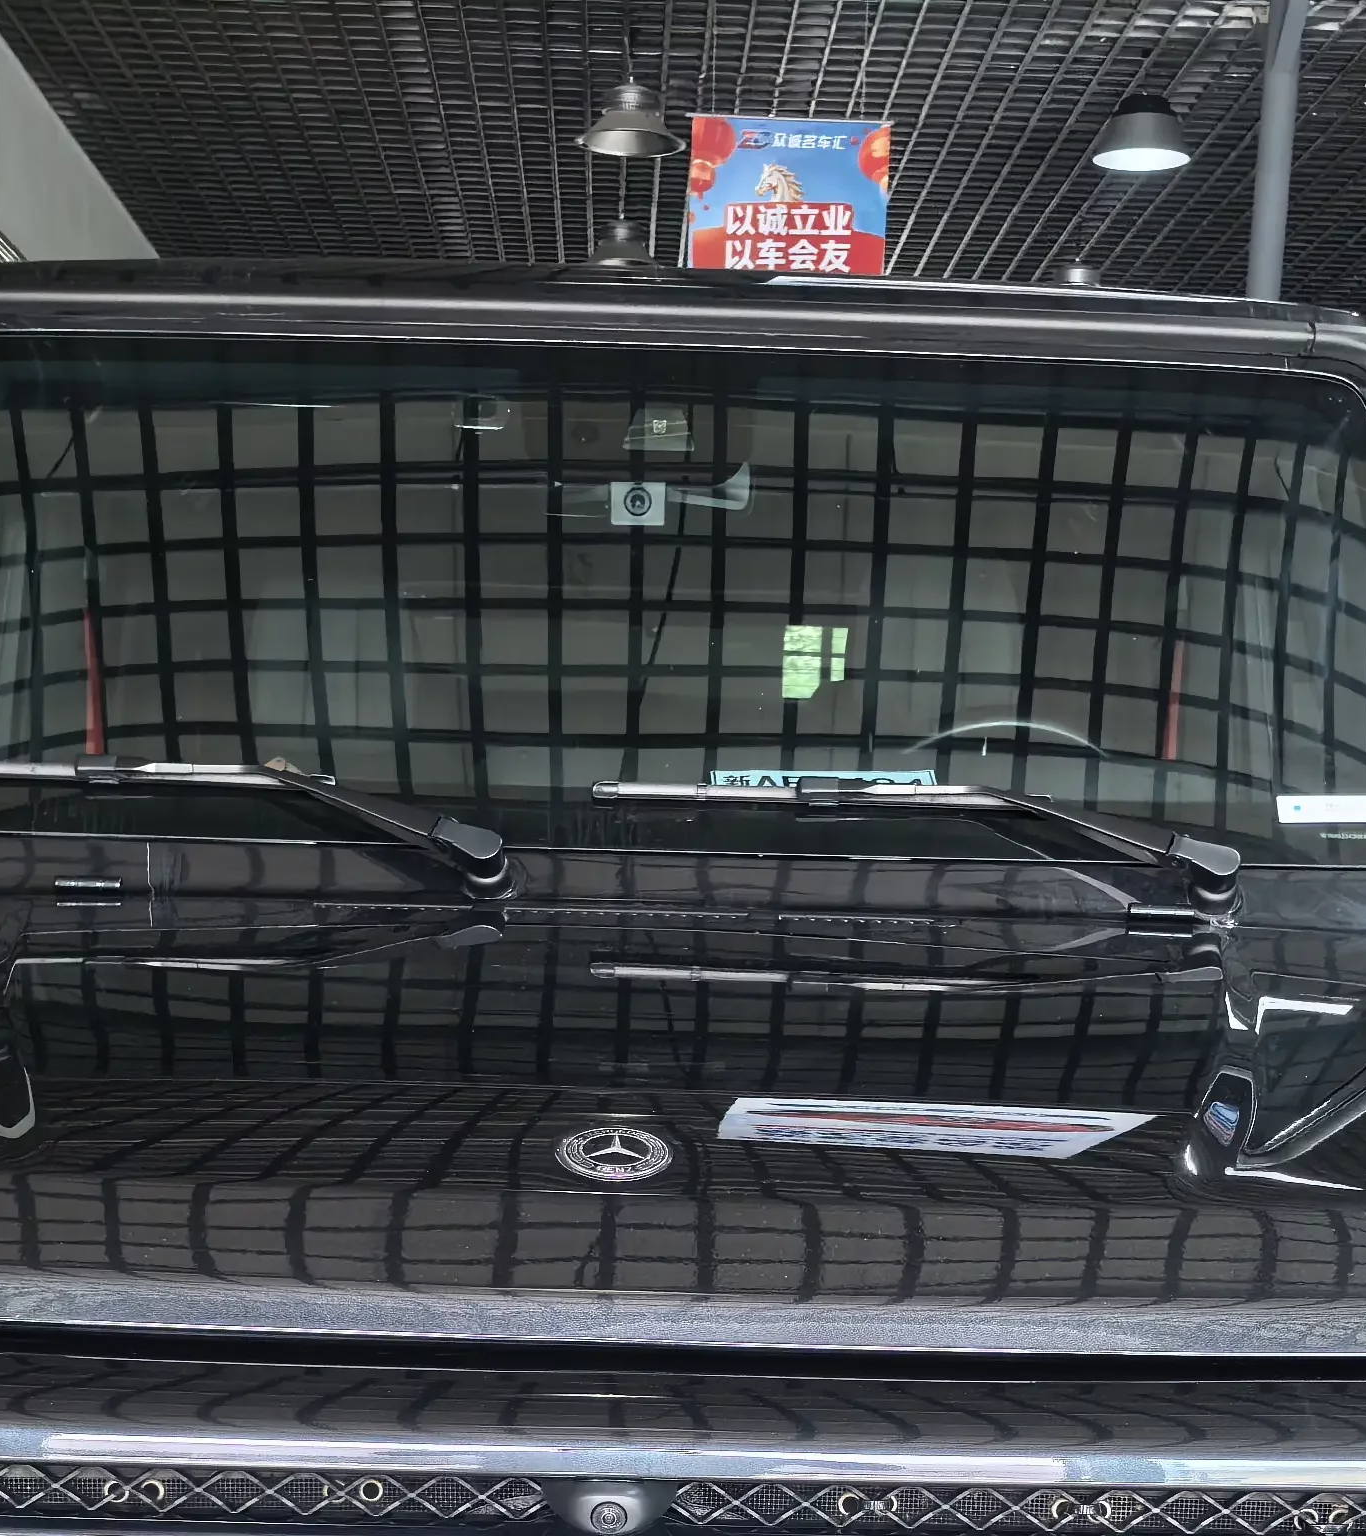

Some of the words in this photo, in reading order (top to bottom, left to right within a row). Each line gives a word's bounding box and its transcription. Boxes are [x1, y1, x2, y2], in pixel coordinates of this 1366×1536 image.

[771, 132, 848, 150] 众诚名车汇
[725, 204, 852, 236] 以诚立业
[724, 239, 851, 273] 以车会友
